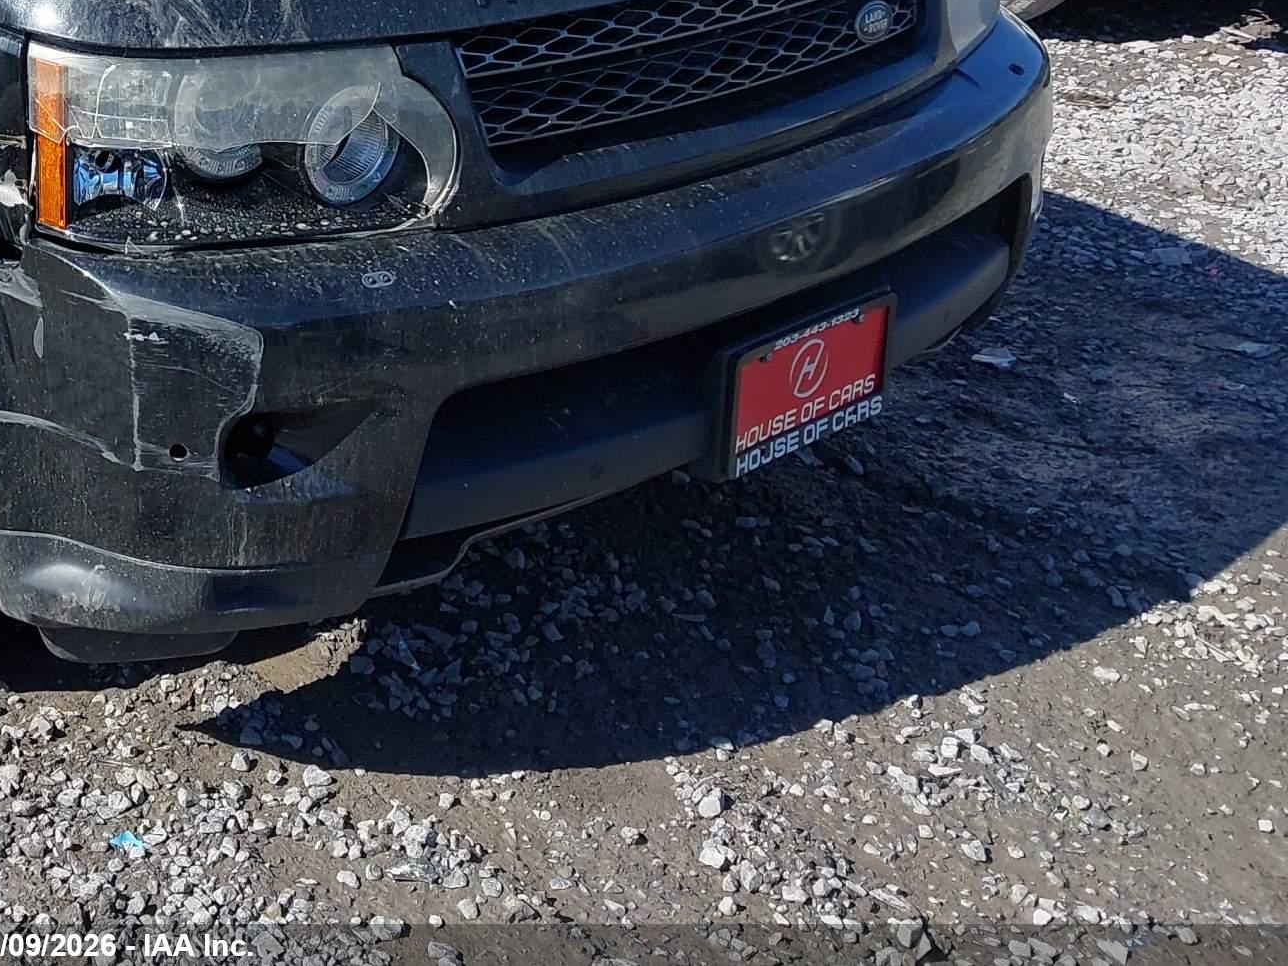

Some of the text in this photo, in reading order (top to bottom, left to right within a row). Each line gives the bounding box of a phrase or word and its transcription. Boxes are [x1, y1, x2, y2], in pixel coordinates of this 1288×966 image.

[865, 9, 883, 25] LAND
[774, 308, 860, 351] 203-443-1323
[734, 373, 876, 456] HOUSE OF CARS
[735, 394, 883, 479] HOUSE OF CARS
